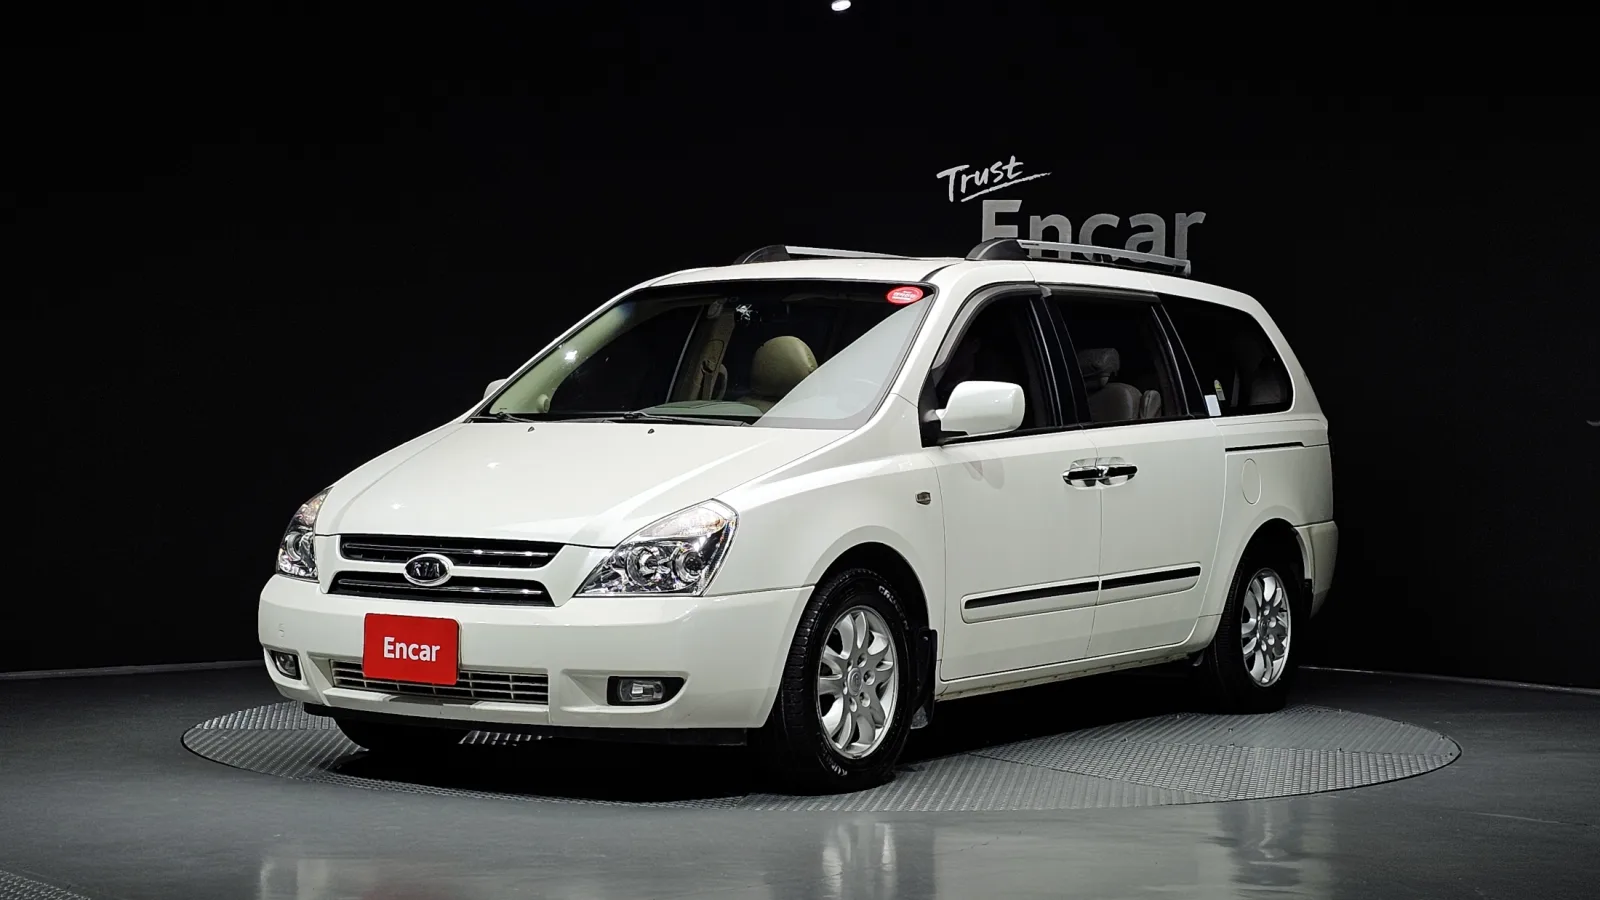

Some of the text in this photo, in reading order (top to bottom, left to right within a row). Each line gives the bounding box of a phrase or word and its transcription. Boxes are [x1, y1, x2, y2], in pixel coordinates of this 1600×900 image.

[936, 155, 1024, 202] Trust
[982, 200, 1207, 263] Encar
[411, 561, 440, 578] KIA
[383, 636, 440, 662] Encar
